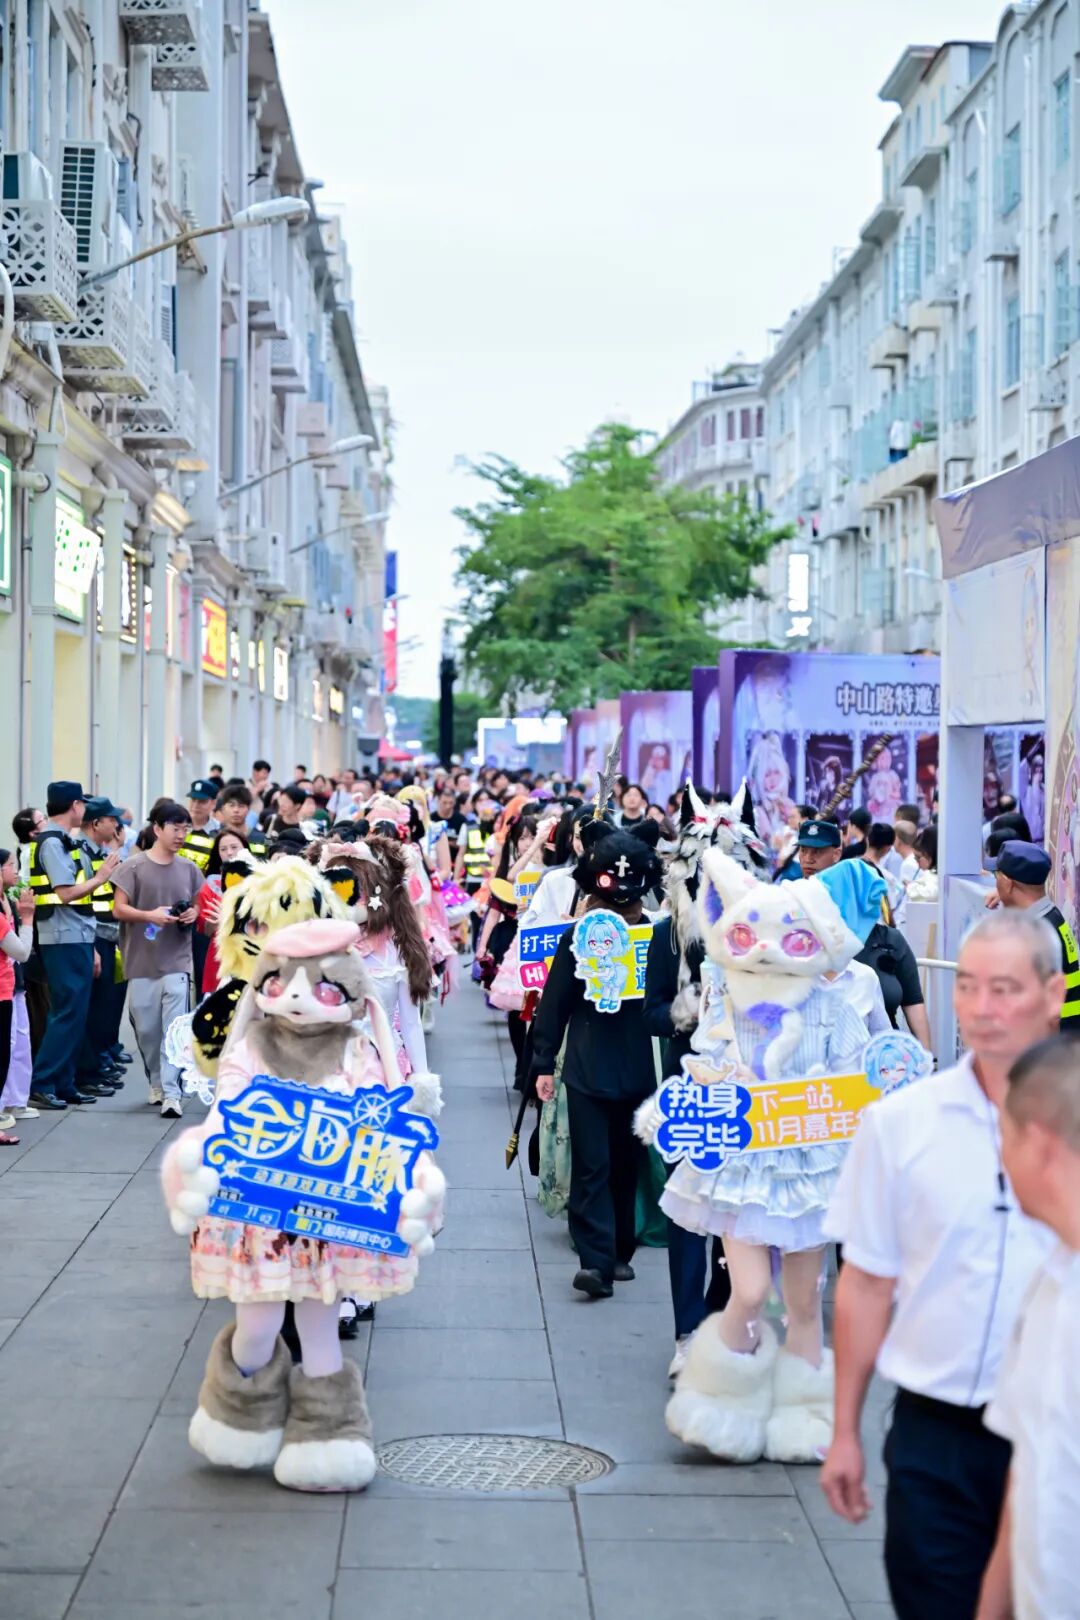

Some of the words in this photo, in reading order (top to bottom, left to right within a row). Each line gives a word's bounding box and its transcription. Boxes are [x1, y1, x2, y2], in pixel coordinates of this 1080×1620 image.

[522, 933, 563, 954] 打卡
[525, 965, 545, 983] Hi
[667, 1082, 742, 1118] 热身
[667, 1122, 741, 1160] 完毕
[756, 1108, 864, 1144] 11月嘉年
